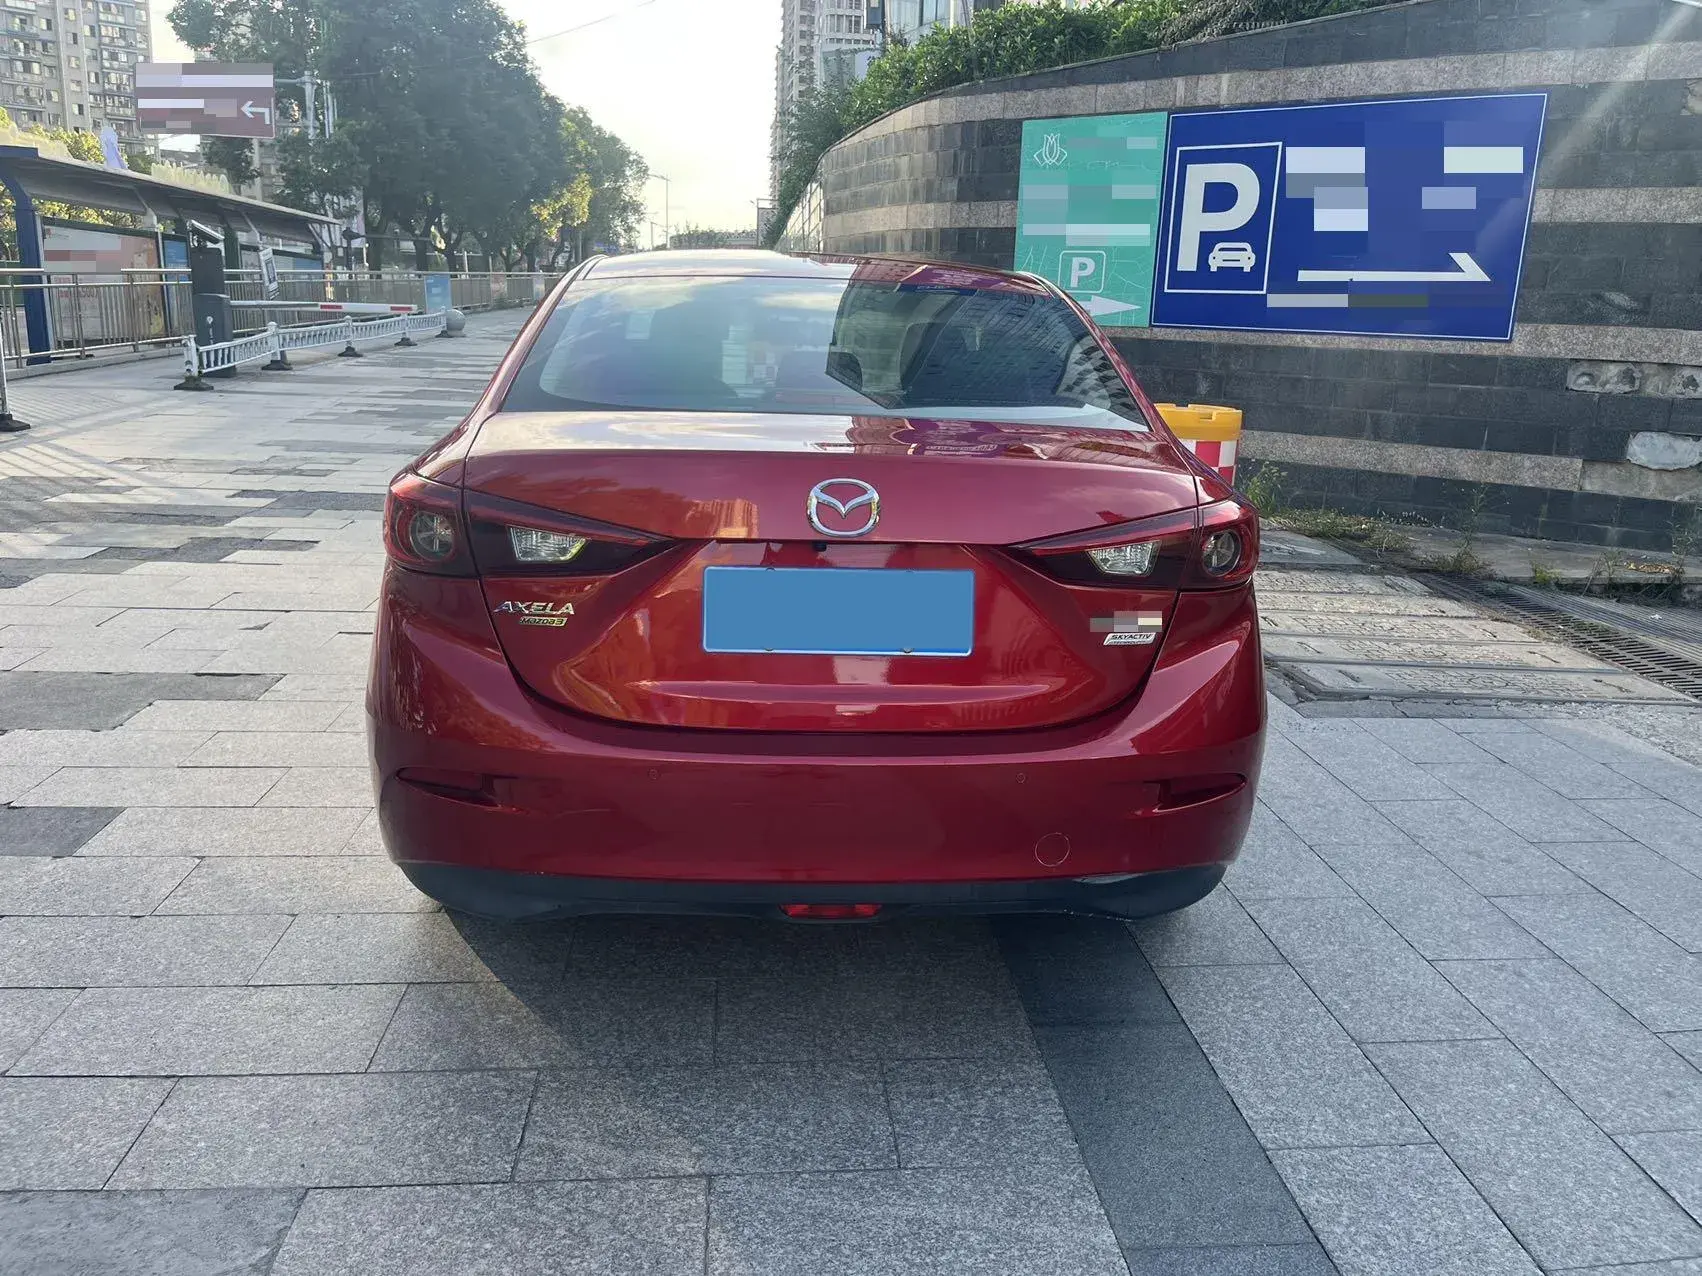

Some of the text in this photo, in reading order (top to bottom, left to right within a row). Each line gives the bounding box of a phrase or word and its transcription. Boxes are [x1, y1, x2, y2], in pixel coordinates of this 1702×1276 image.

[1177, 162, 1260, 272] P
[1070, 256, 1096, 288] P
[493, 601, 574, 614] AXELA
